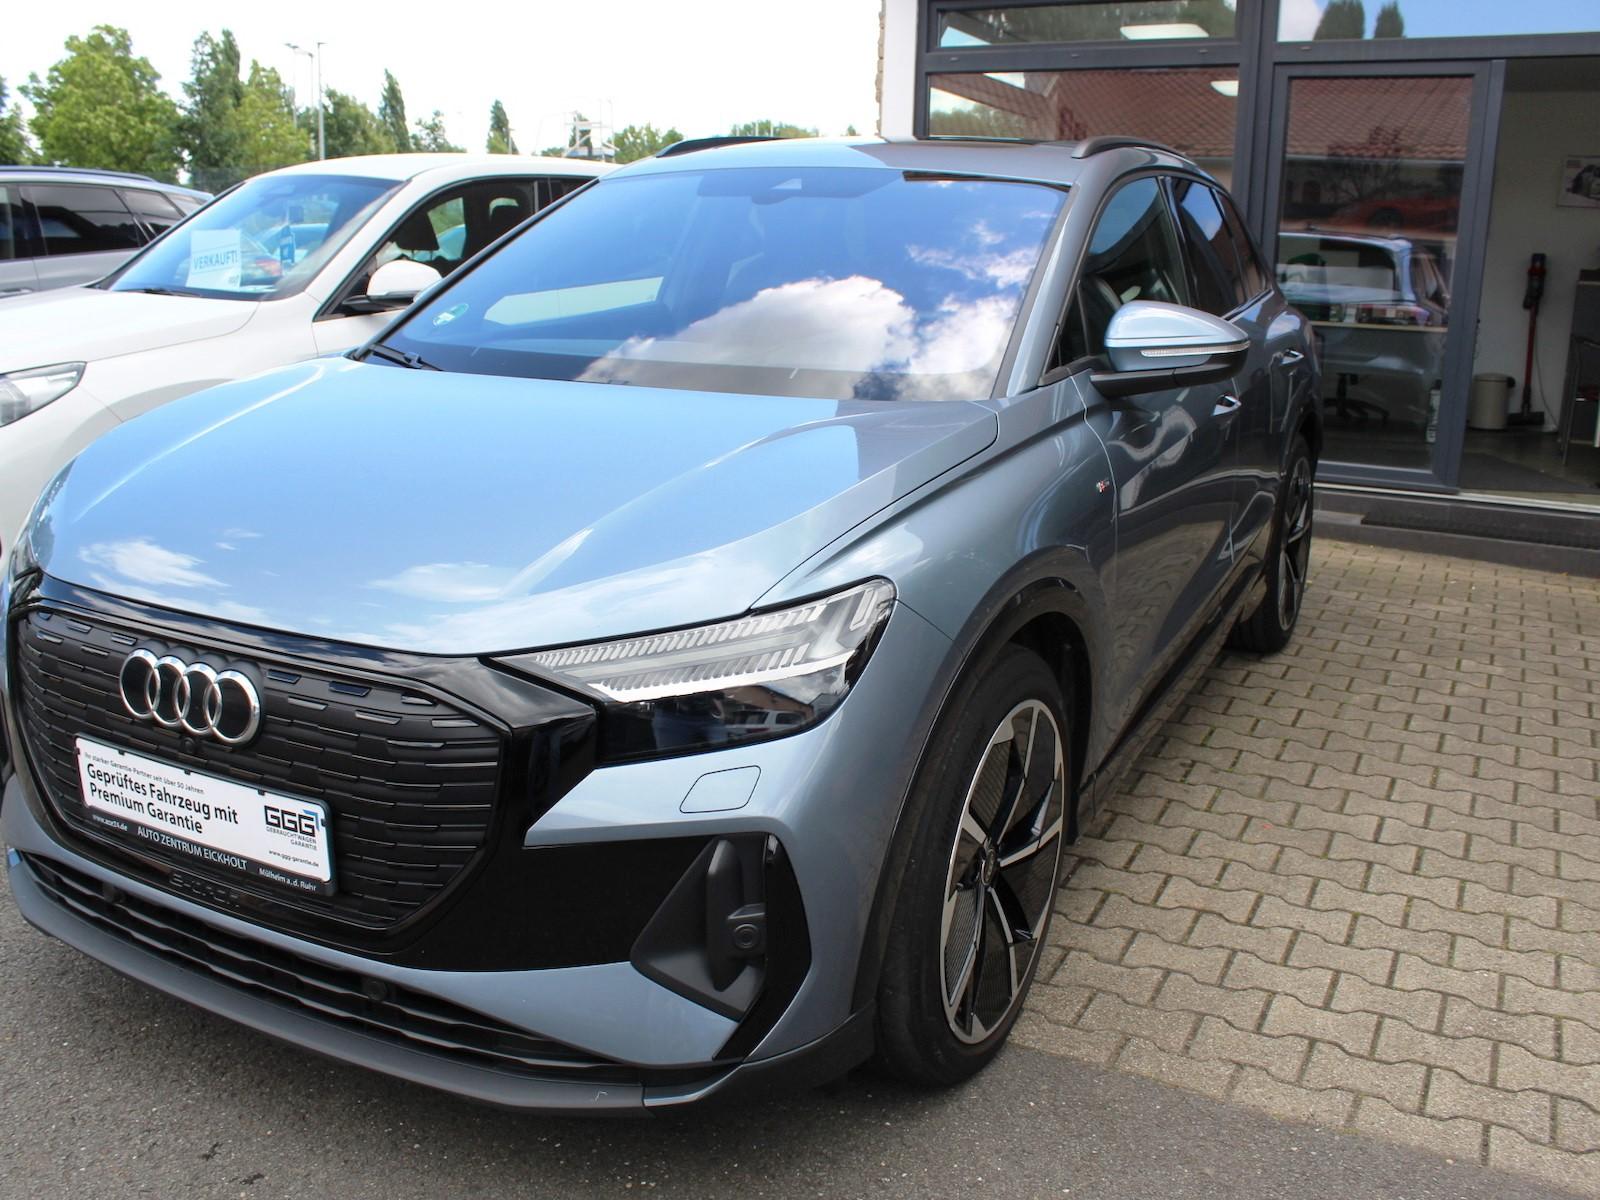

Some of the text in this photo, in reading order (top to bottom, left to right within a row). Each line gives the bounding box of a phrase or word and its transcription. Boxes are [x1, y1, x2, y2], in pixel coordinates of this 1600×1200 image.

[193, 250, 239, 269] VERKAUFT!
[87, 763, 238, 825] Geprüftes Fahrzeug mit
[90, 782, 203, 834] Premium Garantie
[264, 805, 316, 838] GGG
[266, 826, 317, 844] GEBRAUCHTWAGEN
[137, 825, 248, 871] AUTO ZENTRUM EICKHOLT
[290, 839, 318, 851] GARANTIE
[259, 867, 286, 883] Mülheim
[300, 880, 317, 892] Ruhr
